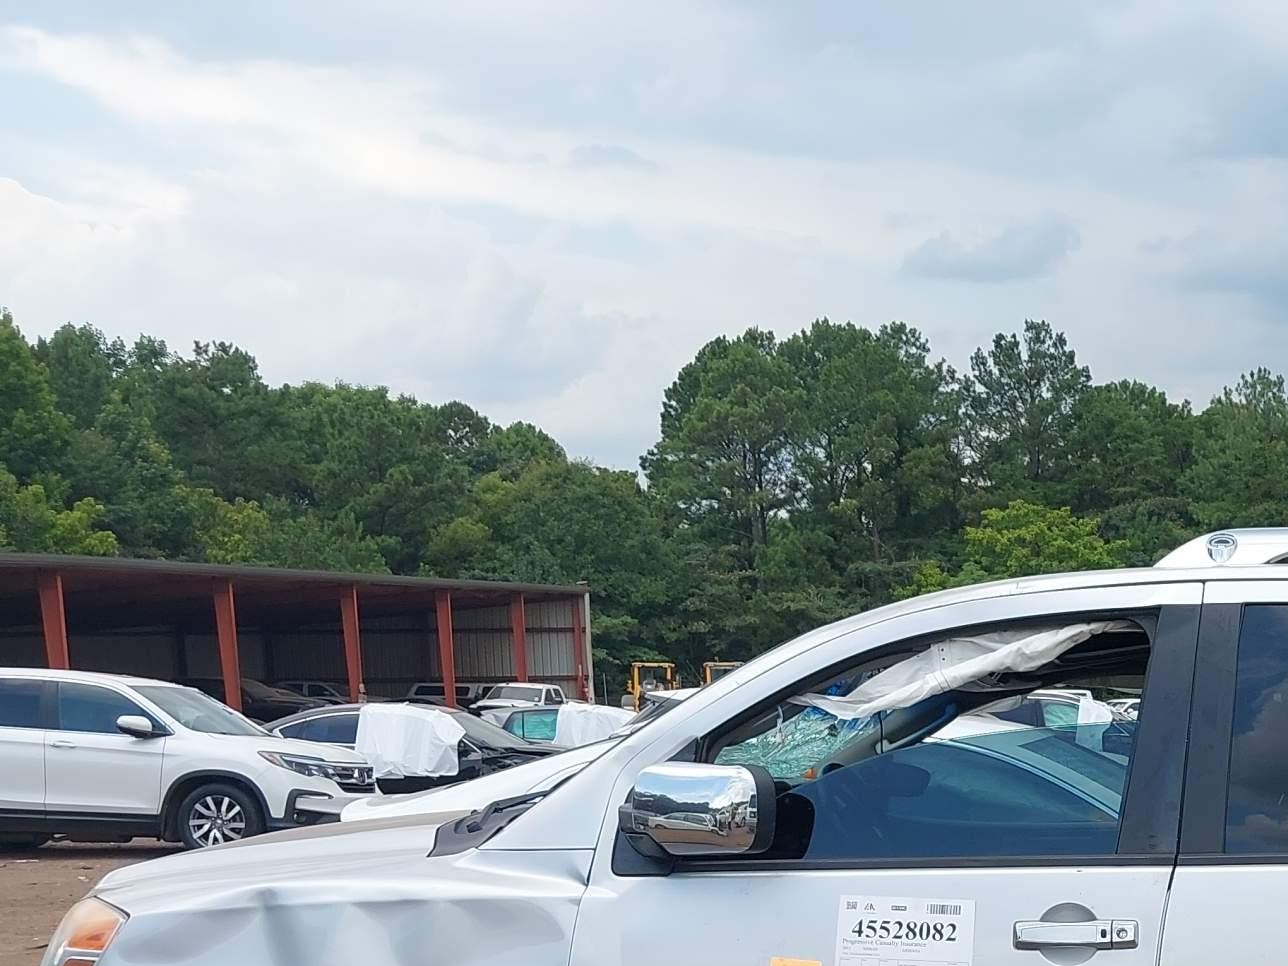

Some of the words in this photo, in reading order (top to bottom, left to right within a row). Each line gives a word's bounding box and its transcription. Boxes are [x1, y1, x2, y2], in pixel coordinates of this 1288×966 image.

[852, 919, 957, 942] 45528082
[843, 938, 873, 946] Progressive
[875, 939, 898, 948] Casualty
